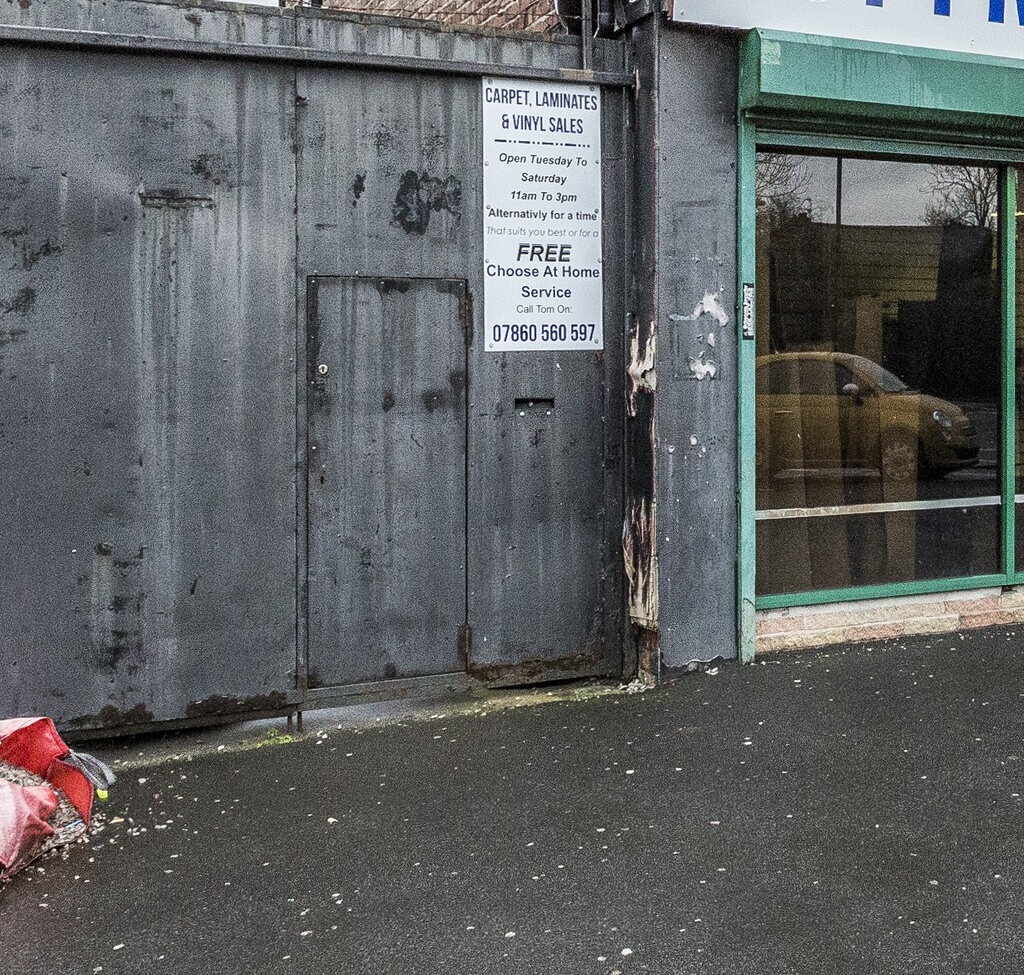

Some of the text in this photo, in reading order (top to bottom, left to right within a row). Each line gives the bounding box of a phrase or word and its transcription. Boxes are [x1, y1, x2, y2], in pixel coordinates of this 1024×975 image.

[485, 87, 598, 111] CARPET, LAMINATES
[501, 114, 584, 135] & VINYL SALES
[499, 153, 588, 168] Open Tuesday To
[521, 172, 567, 186] Saturday
[510, 191, 578, 204] 11am To 3pm
[487, 208, 598, 222] Alternativly for a time
[486, 226, 506, 236] That
[508, 227, 527, 236] suits
[529, 229, 546, 238] you
[547, 227, 566, 237] best
[568, 230, 578, 238] or
[579, 228, 592, 238] for
[516, 242, 572, 263] FREE
[486, 264, 600, 279] Choose At Home
[521, 286, 572, 299] Service
[515, 304, 573, 314] Call Tom On:
[492, 323, 595, 342] 07860 560 597
